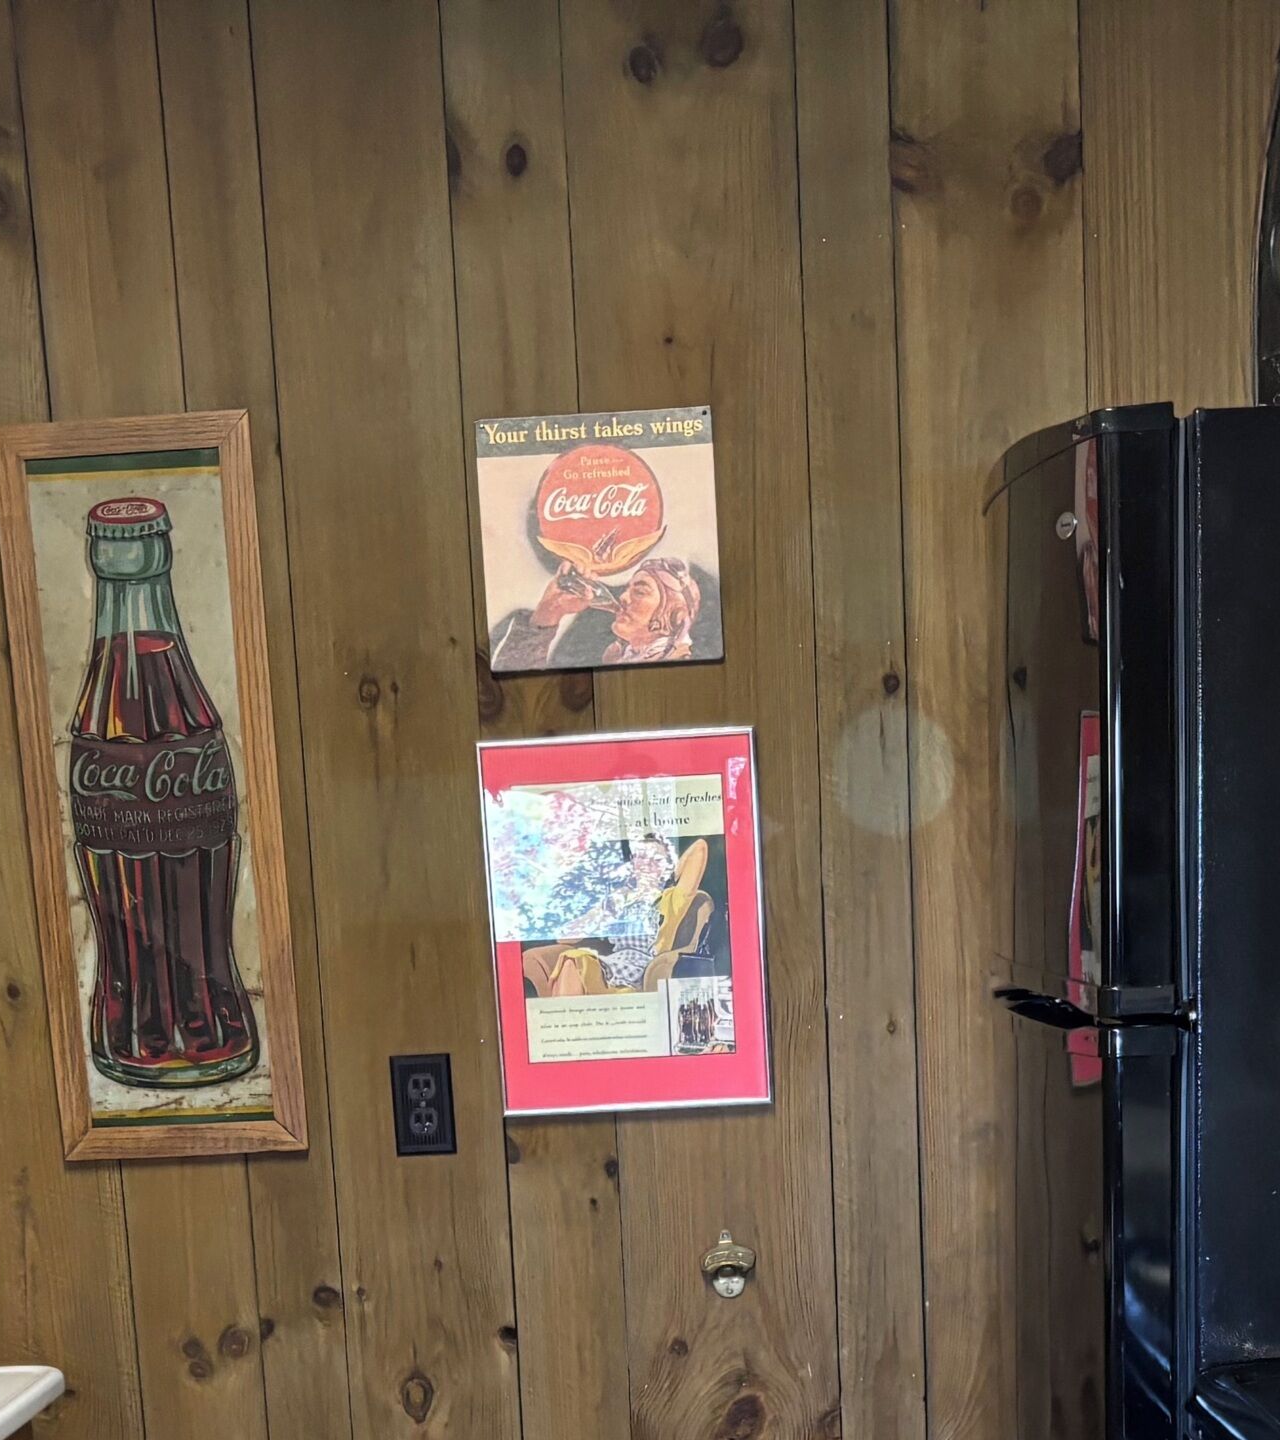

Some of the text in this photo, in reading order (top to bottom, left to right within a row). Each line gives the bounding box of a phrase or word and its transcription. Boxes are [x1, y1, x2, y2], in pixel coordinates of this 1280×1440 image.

[483, 417, 704, 445] Your thirst takes wings
[563, 465, 631, 481] Go refreshed
[543, 483, 650, 522] Coca-Cola
[113, 808, 151, 823] MARK
